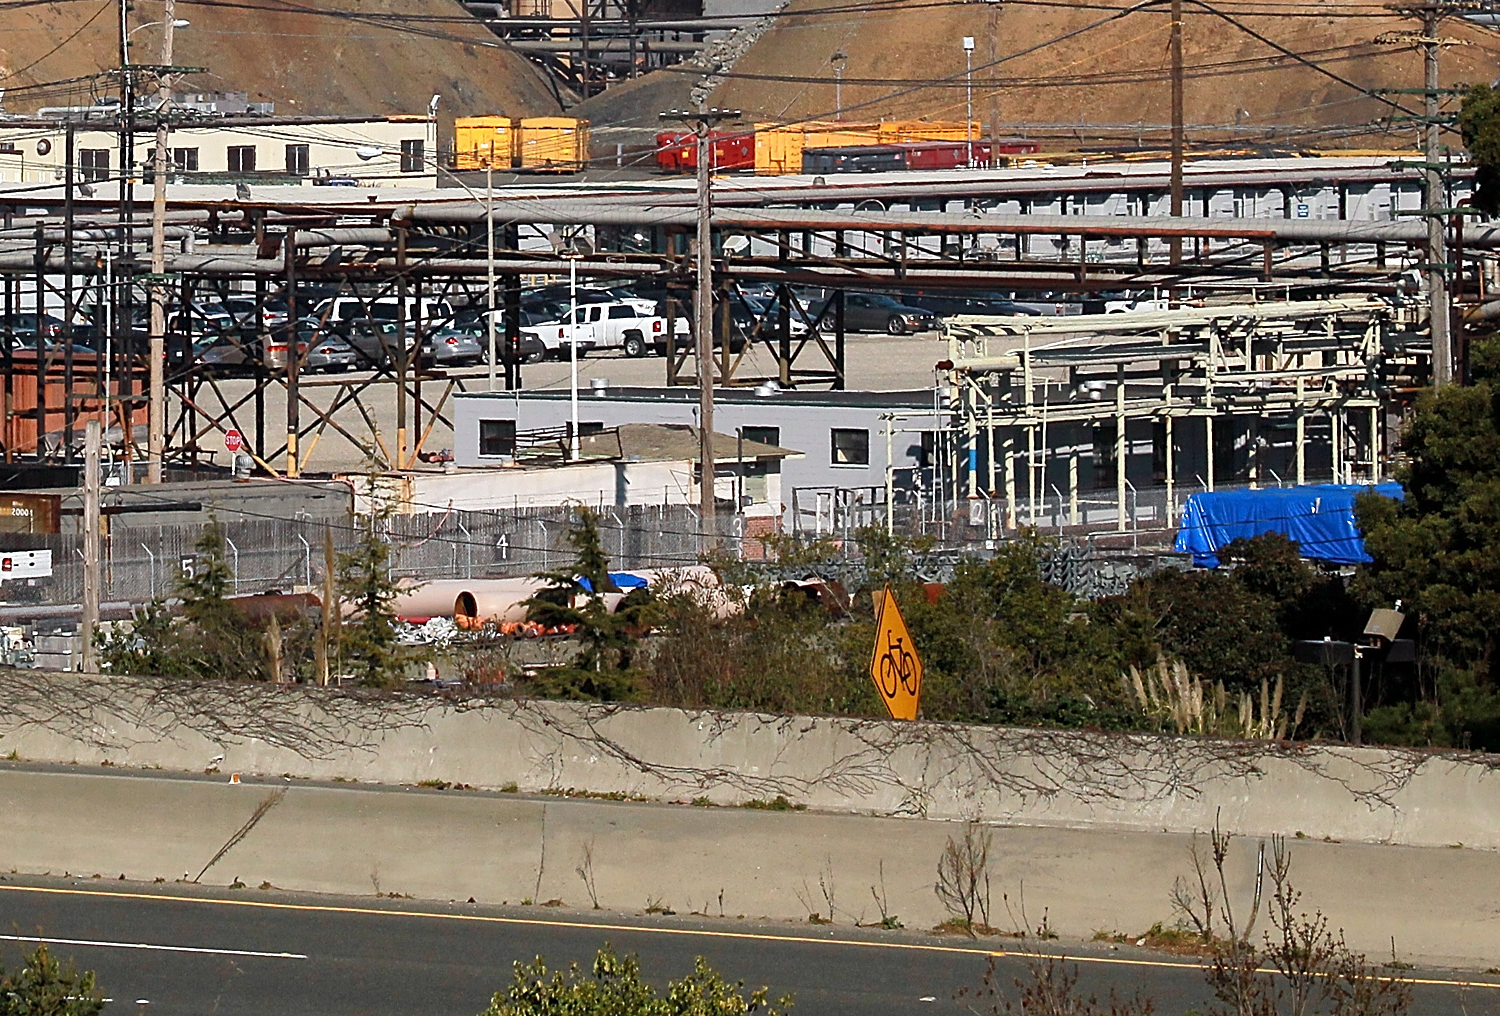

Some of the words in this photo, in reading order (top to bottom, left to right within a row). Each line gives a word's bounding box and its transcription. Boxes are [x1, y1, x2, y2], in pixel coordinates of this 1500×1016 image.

[226, 436, 240, 445] STOP
[496, 533, 509, 560] 4
[182, 558, 194, 580] 5
